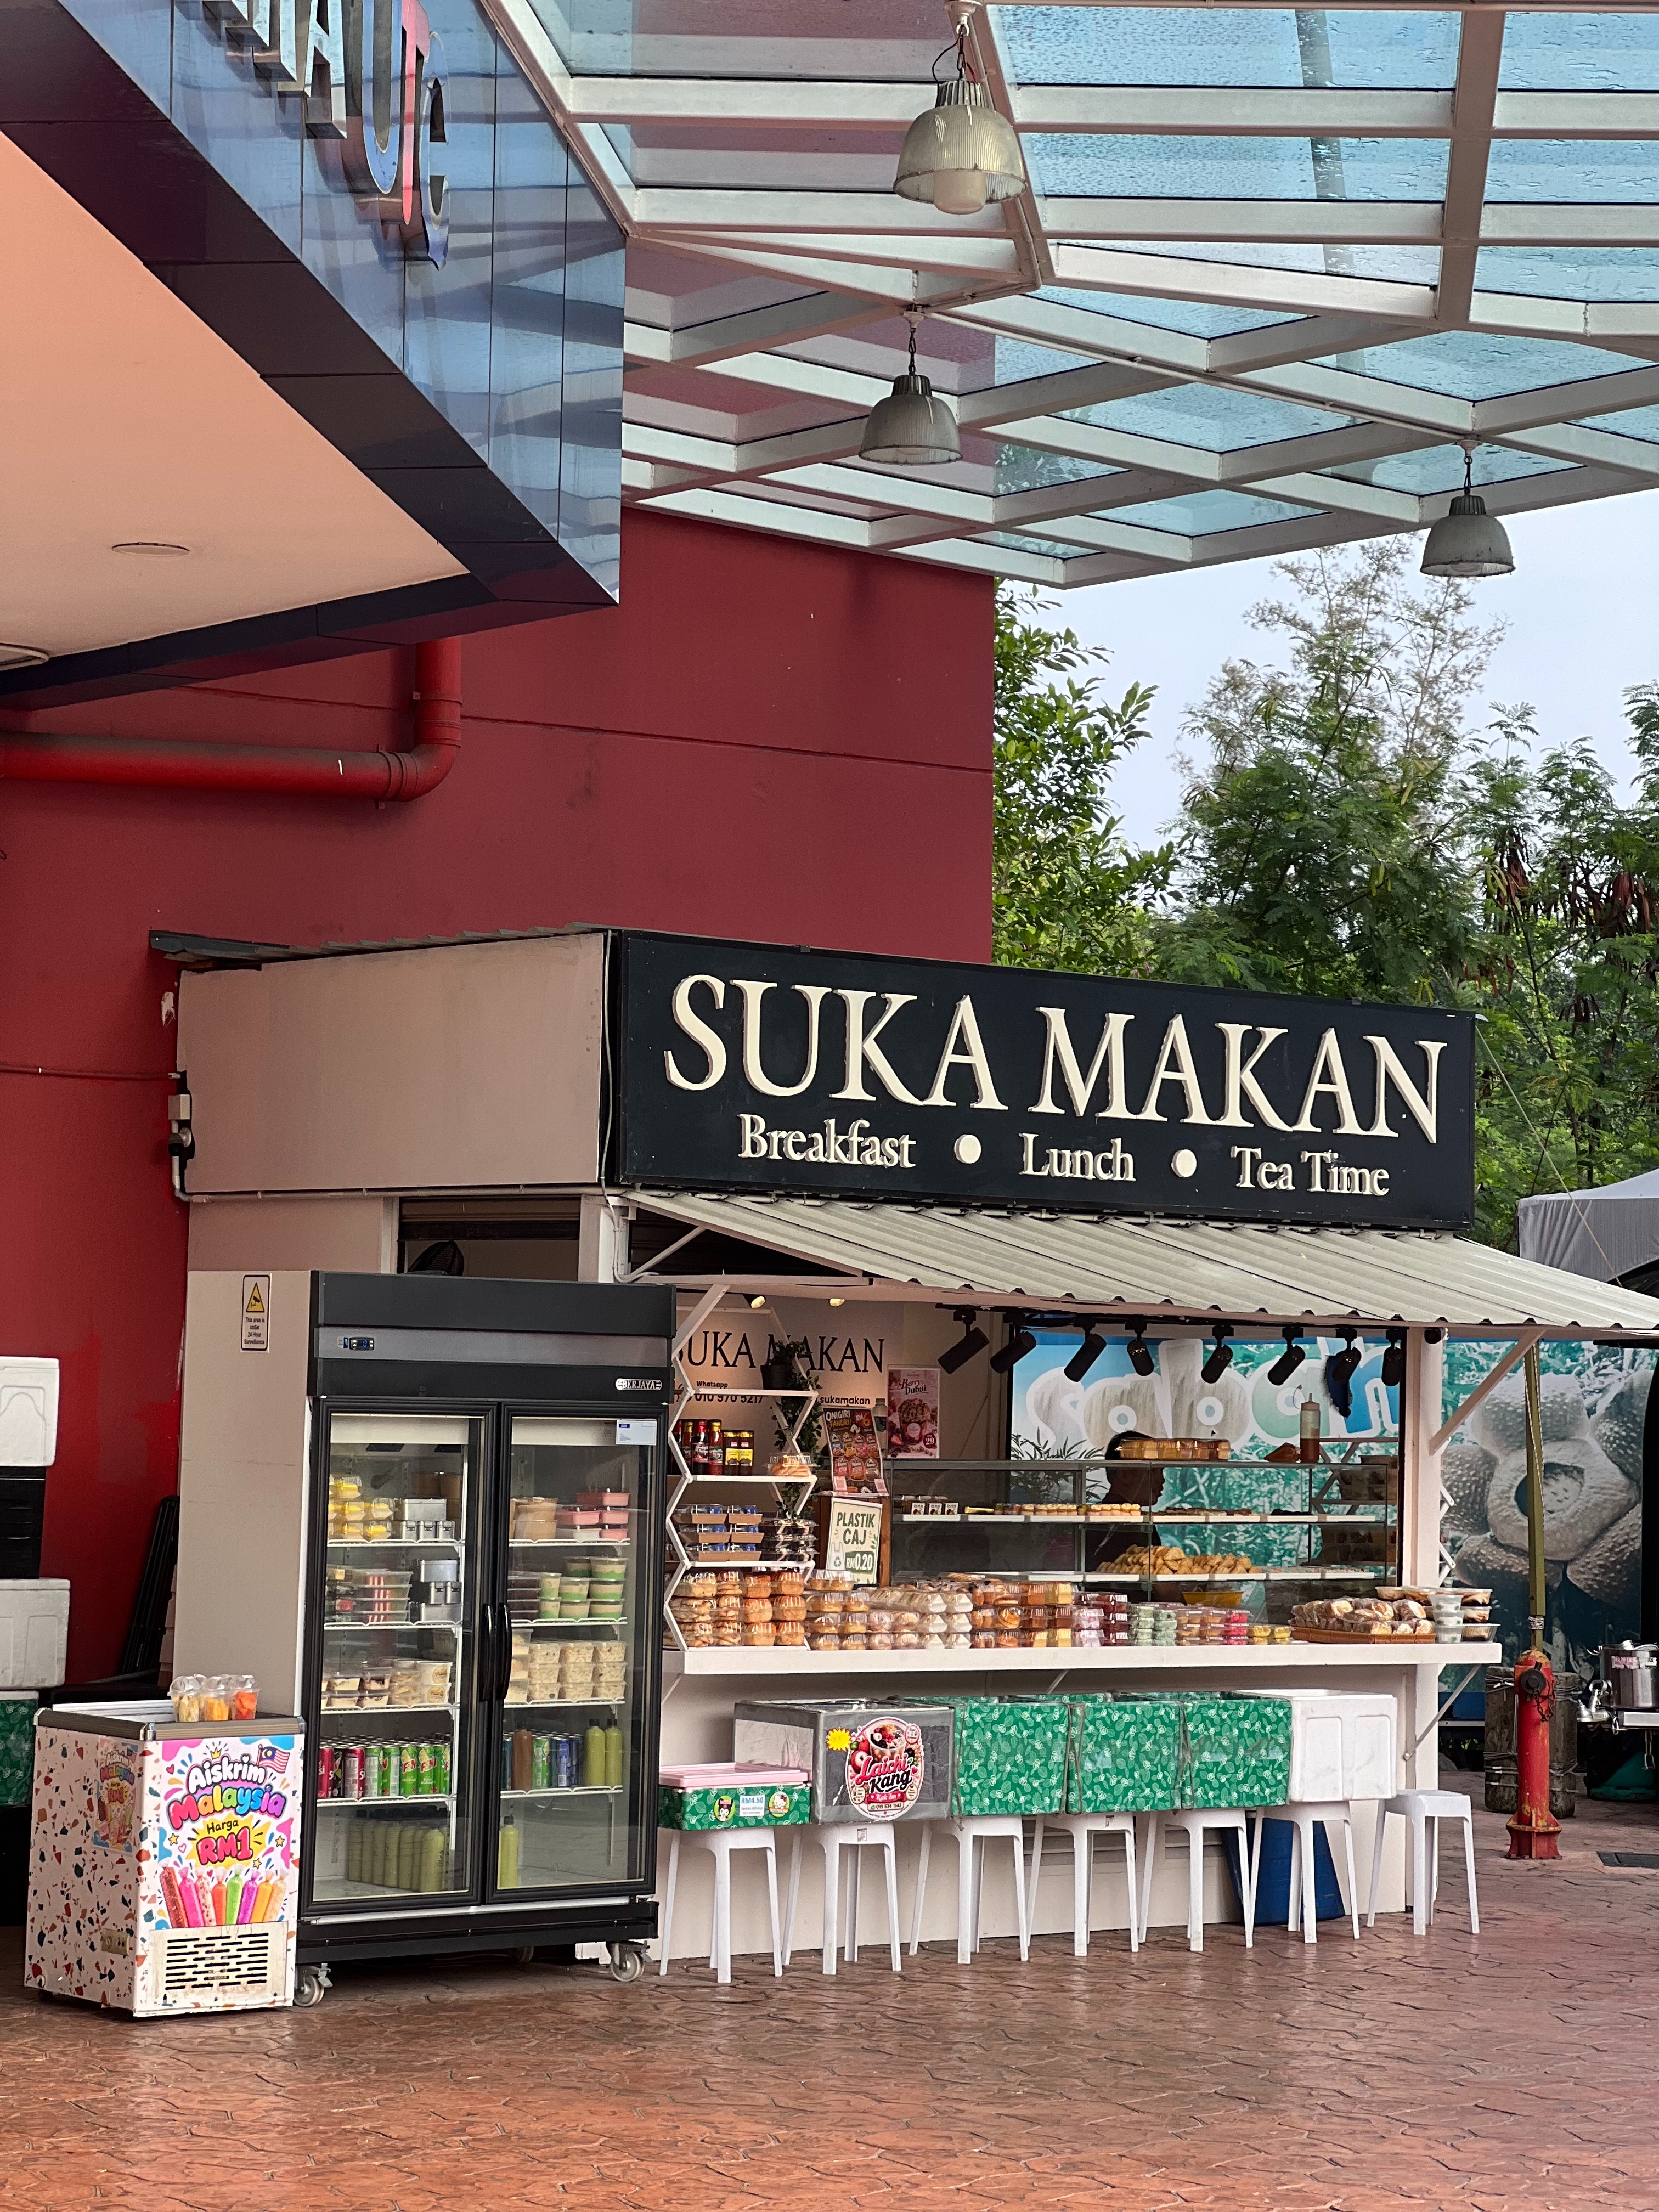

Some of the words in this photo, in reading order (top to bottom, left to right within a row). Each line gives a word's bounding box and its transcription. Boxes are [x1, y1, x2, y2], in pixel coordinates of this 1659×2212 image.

[663, 974, 1008, 1110] SUKA
[1028, 1006, 1448, 1144] MAKAN
[737, 1113, 916, 1168] Breakfast
[1019, 1133, 1136, 1182] Lunch
[1231, 1146, 1296, 1191] Tea
[1301, 1150, 1390, 1197] Time
[678, 1330, 757, 1368] UKA
[622, 1379, 656, 1389] BERJAYA
[696, 1380, 729, 1389] Whatsapp
[897, 1378, 921, 1390] Berry
[905, 1384, 927, 1395] Dubai
[820, 1395, 870, 1404] sukamakan
[825, 1410, 850, 1421] ONIGIRI
[862, 1413, 870, 1427] 6
[925, 1437, 935, 1446] 29
[837, 1512, 876, 1528] PLASTIK
[843, 1528, 867, 1545] CAJ
[846, 1553, 873, 1571] RM0.20
[188, 1754, 267, 1794] Aiskrim
[855, 1754, 909, 1785] Laichi
[869, 1770, 913, 1793] Kang
[167, 1784, 287, 1830] Malaysia
[207, 1820, 239, 1834] Harga
[197, 1826, 253, 1865] RM1
